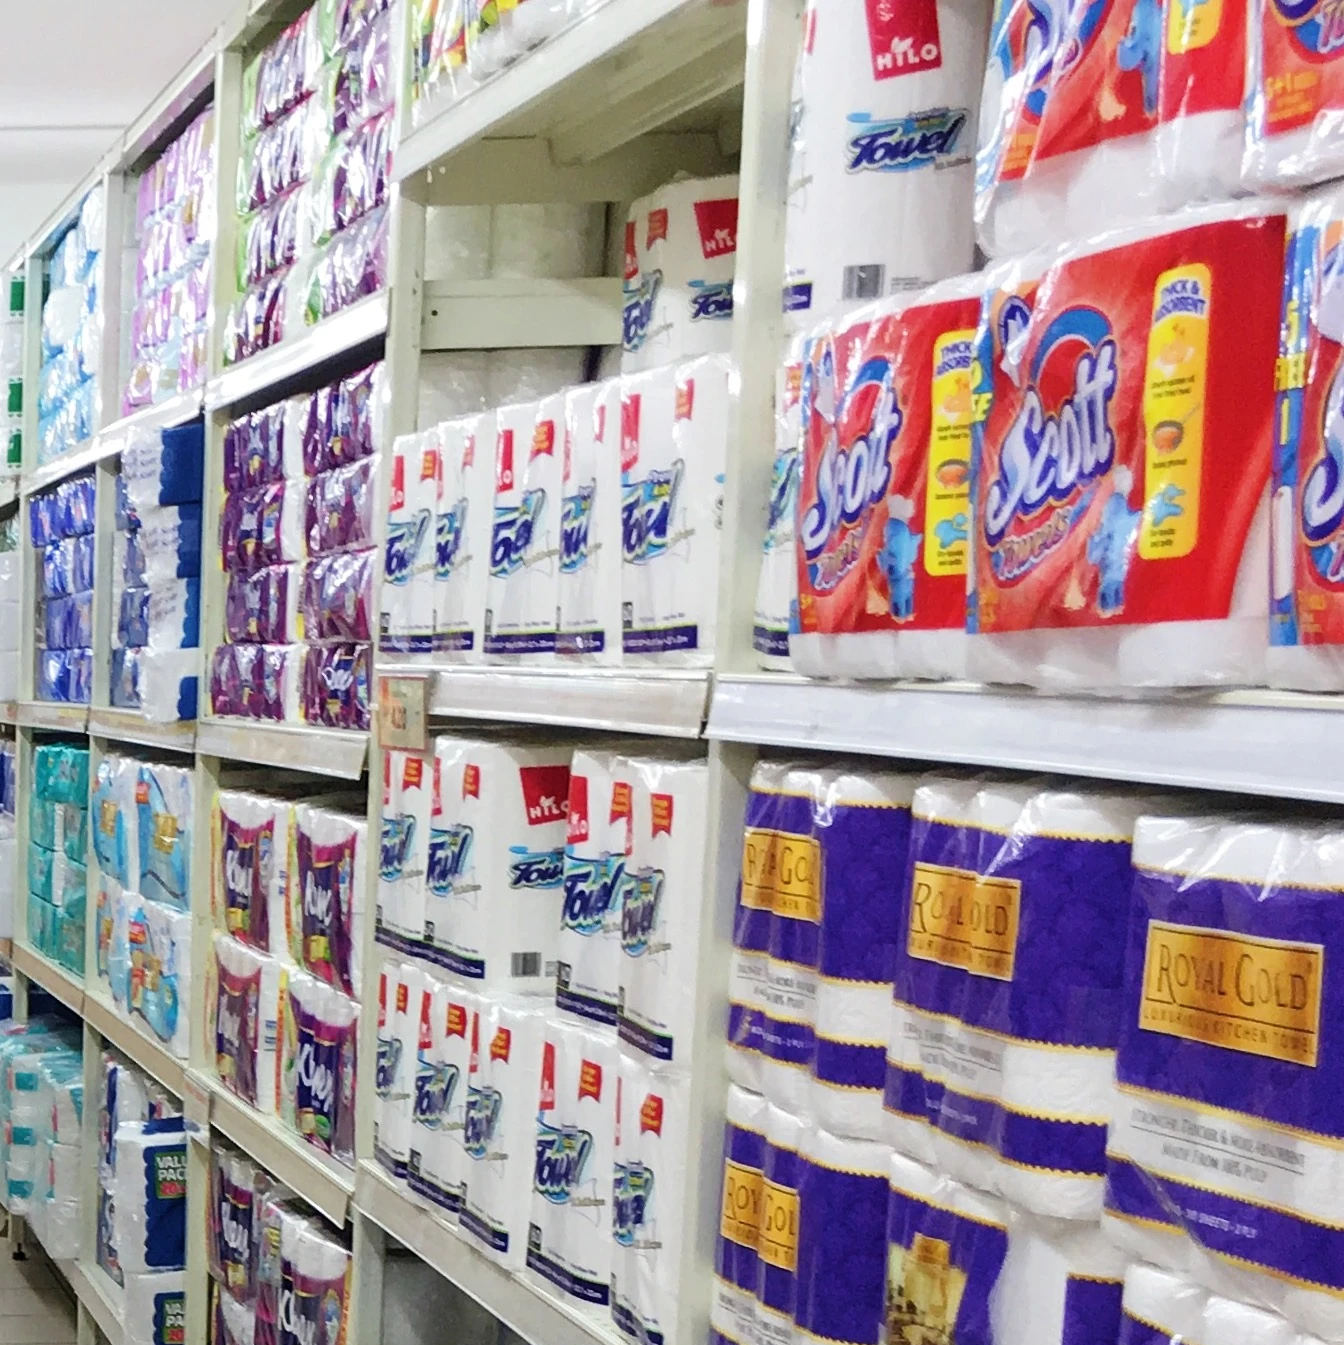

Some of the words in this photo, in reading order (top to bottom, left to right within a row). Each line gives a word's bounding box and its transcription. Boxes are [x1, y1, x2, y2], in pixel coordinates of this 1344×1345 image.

[877, 43, 938, 72] HILO
[849, 114, 967, 170] Towel
[692, 292, 734, 321] Tow
[984, 338, 1116, 548] Scott
[513, 859, 563, 887] Tow
[1156, 944, 1227, 1004] ROYAL
[1233, 953, 1310, 1011] GOLD
[157, 1155, 187, 1170] VALU
[158, 1168, 187, 1182] PAC
